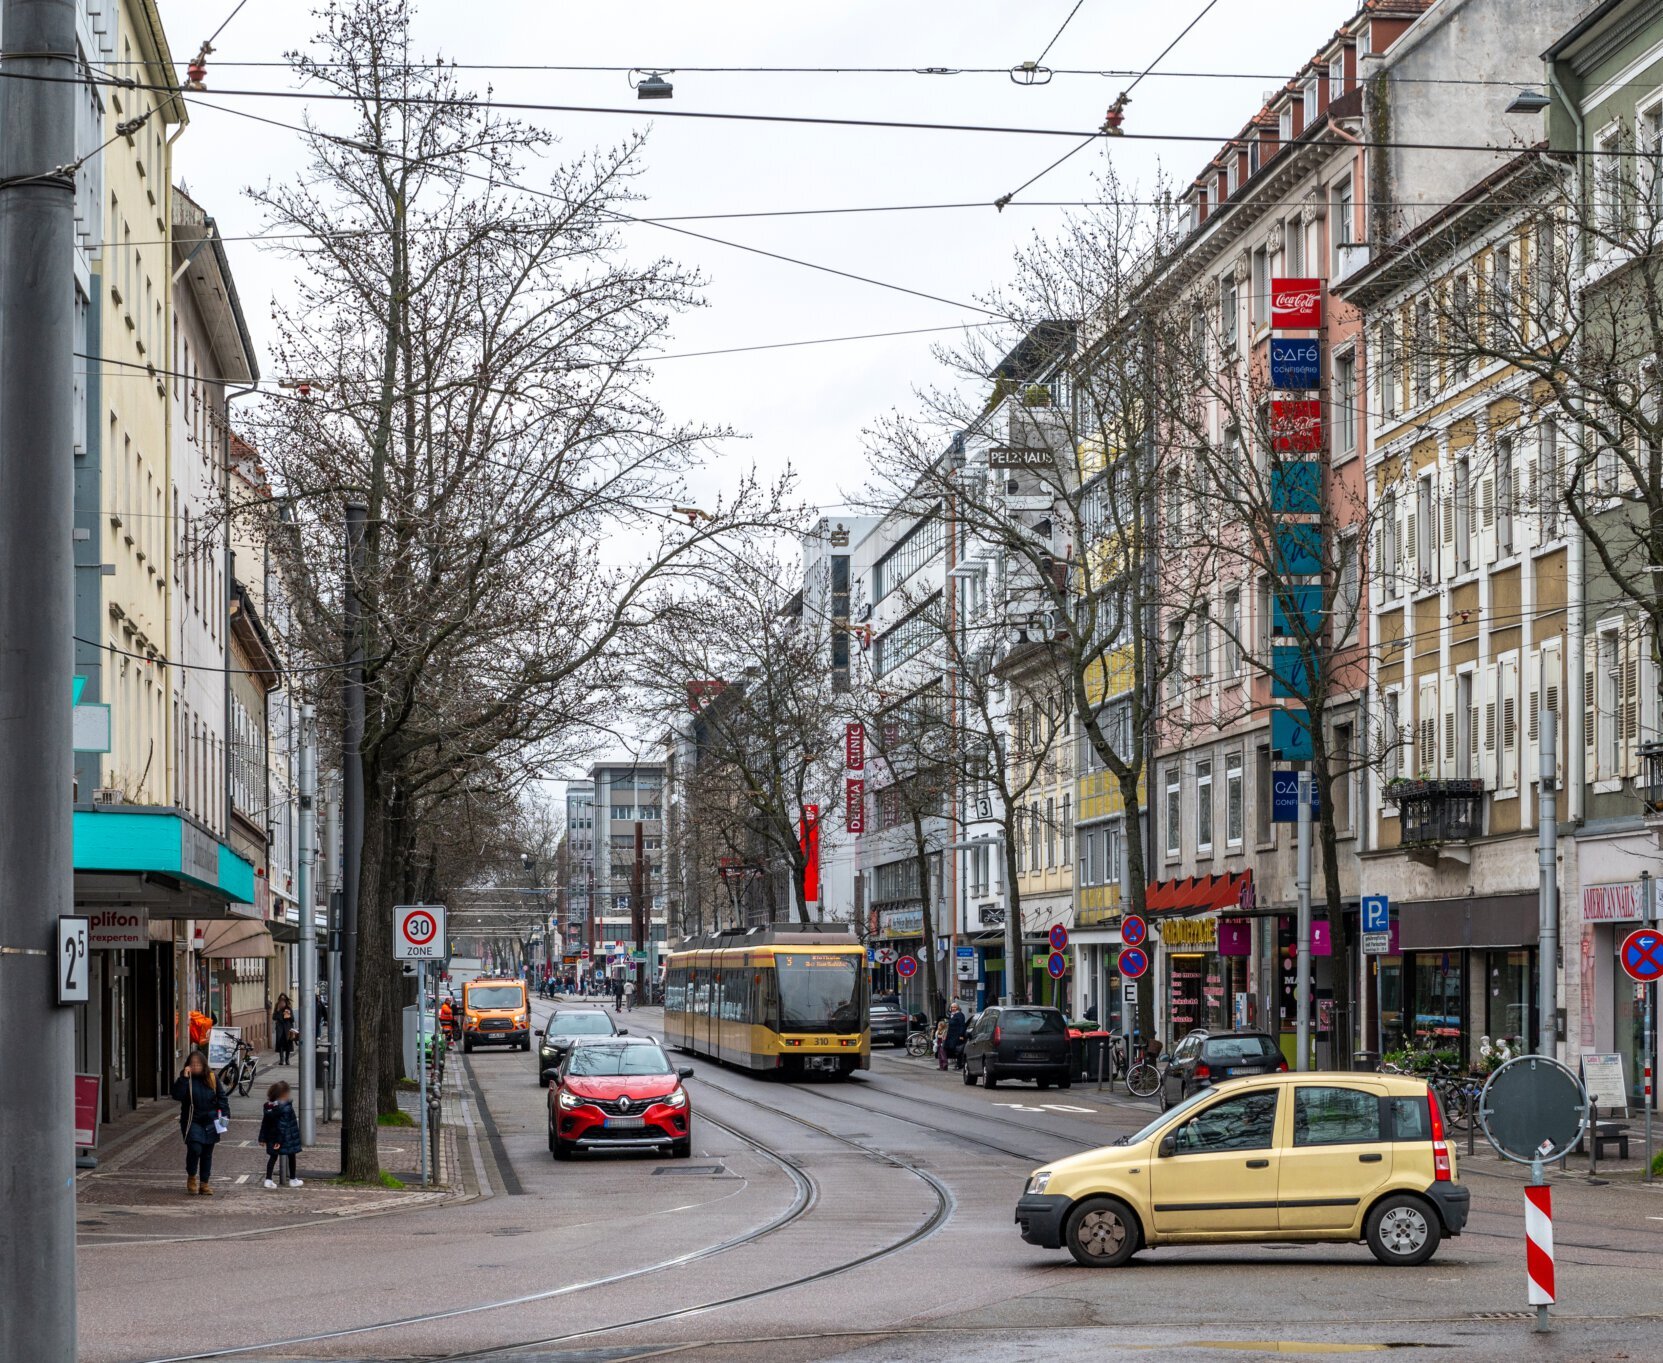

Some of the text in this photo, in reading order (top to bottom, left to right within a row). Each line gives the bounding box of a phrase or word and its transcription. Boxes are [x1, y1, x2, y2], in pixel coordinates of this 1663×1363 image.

[1276, 293, 1315, 307] Coca-Cola
[850, 727, 861, 767] CLINIC
[850, 783, 861, 829] DERMA
[980, 800, 988, 816] 3
[1583, 885, 1636, 920] AMERICAN NAILS
[1368, 901, 1383, 928] P
[410, 920, 430, 936] 30
[407, 947, 433, 956] ZONE
[1125, 985, 1136, 1001] E
[814, 1037, 829, 1046] 310
